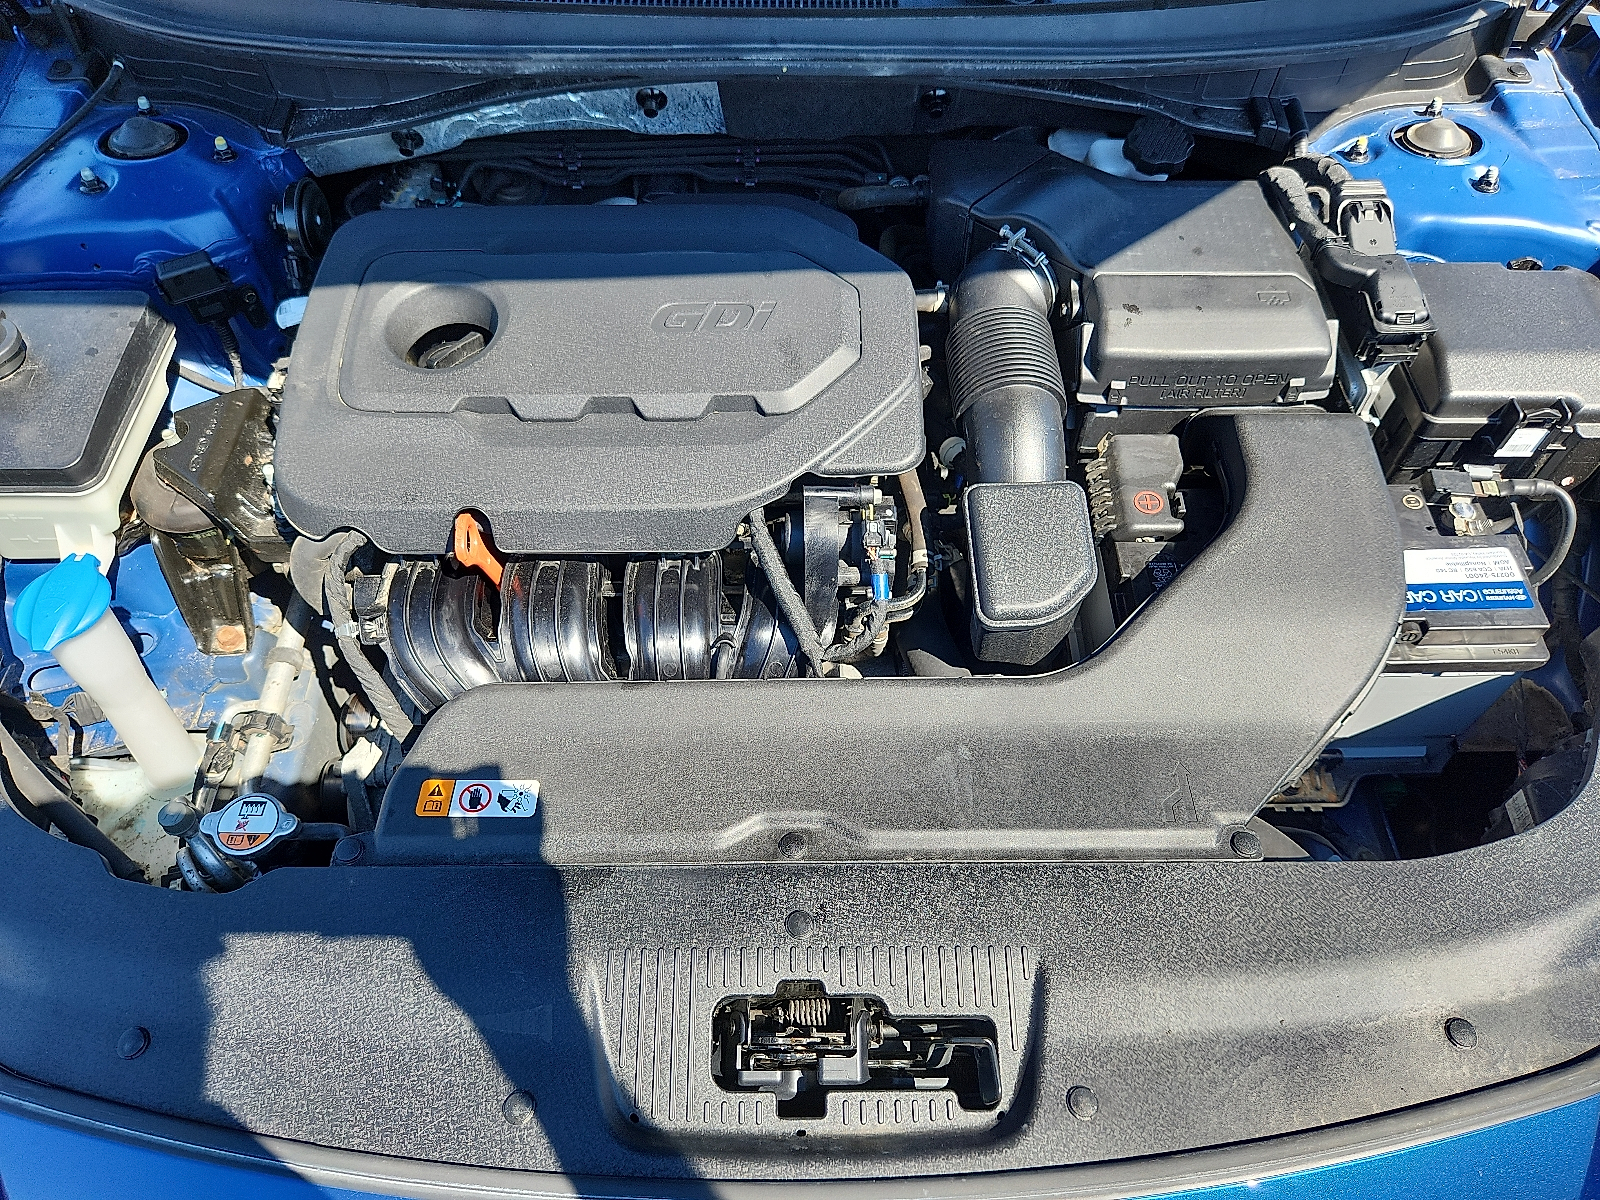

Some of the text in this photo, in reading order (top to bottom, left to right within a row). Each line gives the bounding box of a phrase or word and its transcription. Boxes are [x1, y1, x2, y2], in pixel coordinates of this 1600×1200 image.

[650, 300, 778, 333] GDi
[1128, 373, 1289, 387] PULL OUT TO OPEN
[1438, 589, 1478, 603] CAR
